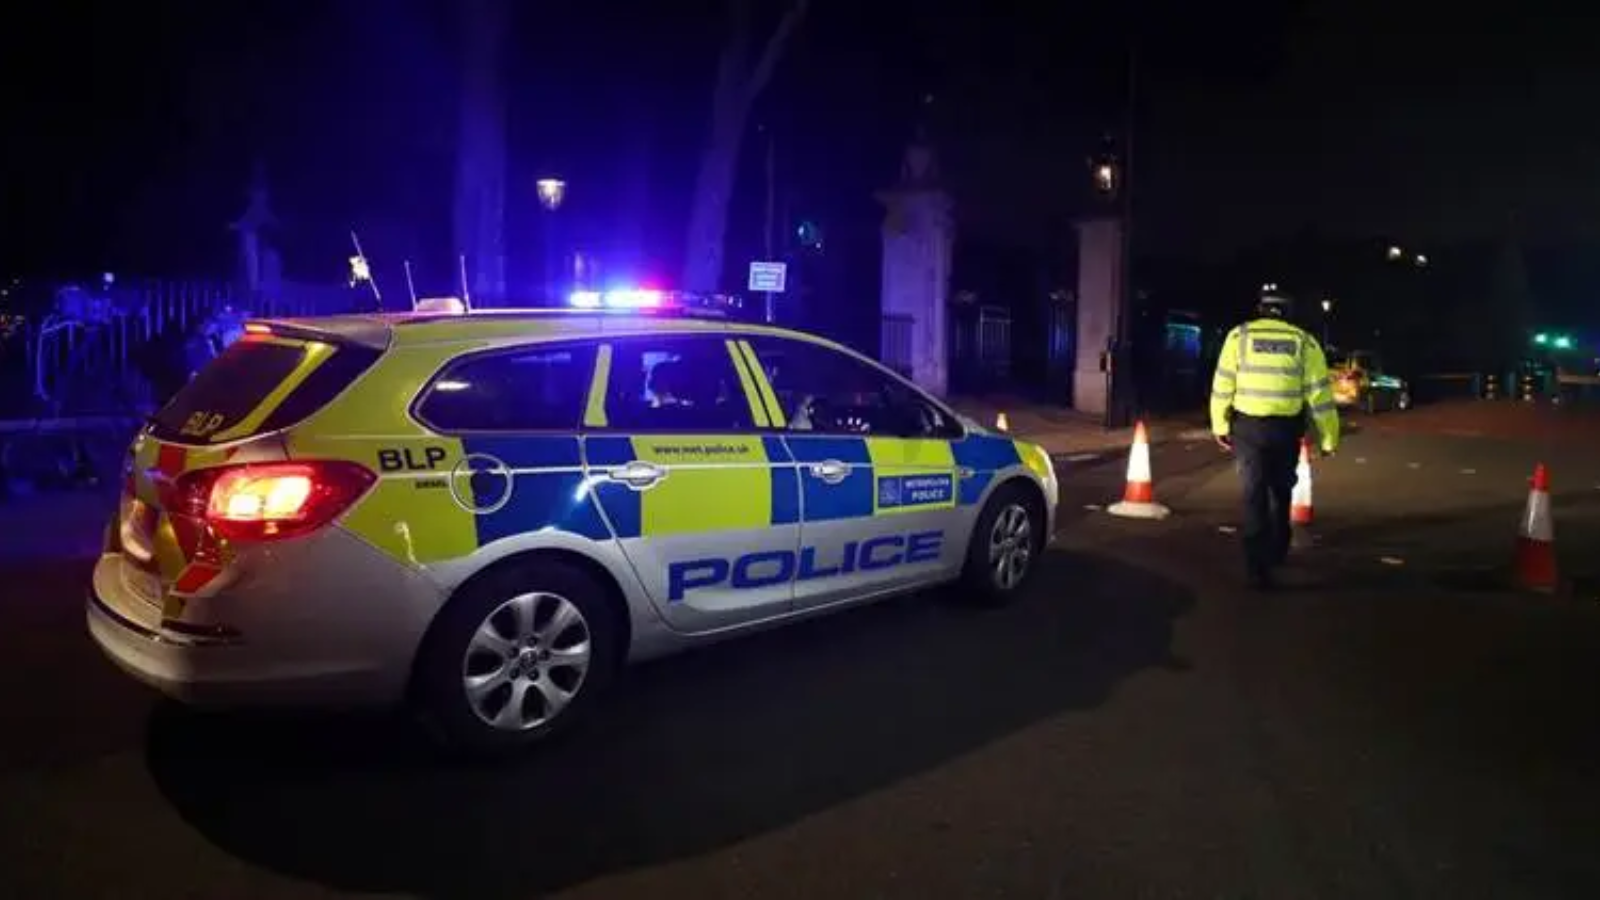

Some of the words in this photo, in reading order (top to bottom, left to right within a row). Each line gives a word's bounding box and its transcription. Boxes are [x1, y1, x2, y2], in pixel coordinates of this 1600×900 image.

[378, 447, 446, 471] BLP
[911, 489, 945, 501] POLICE
[667, 530, 944, 601] POLICE
